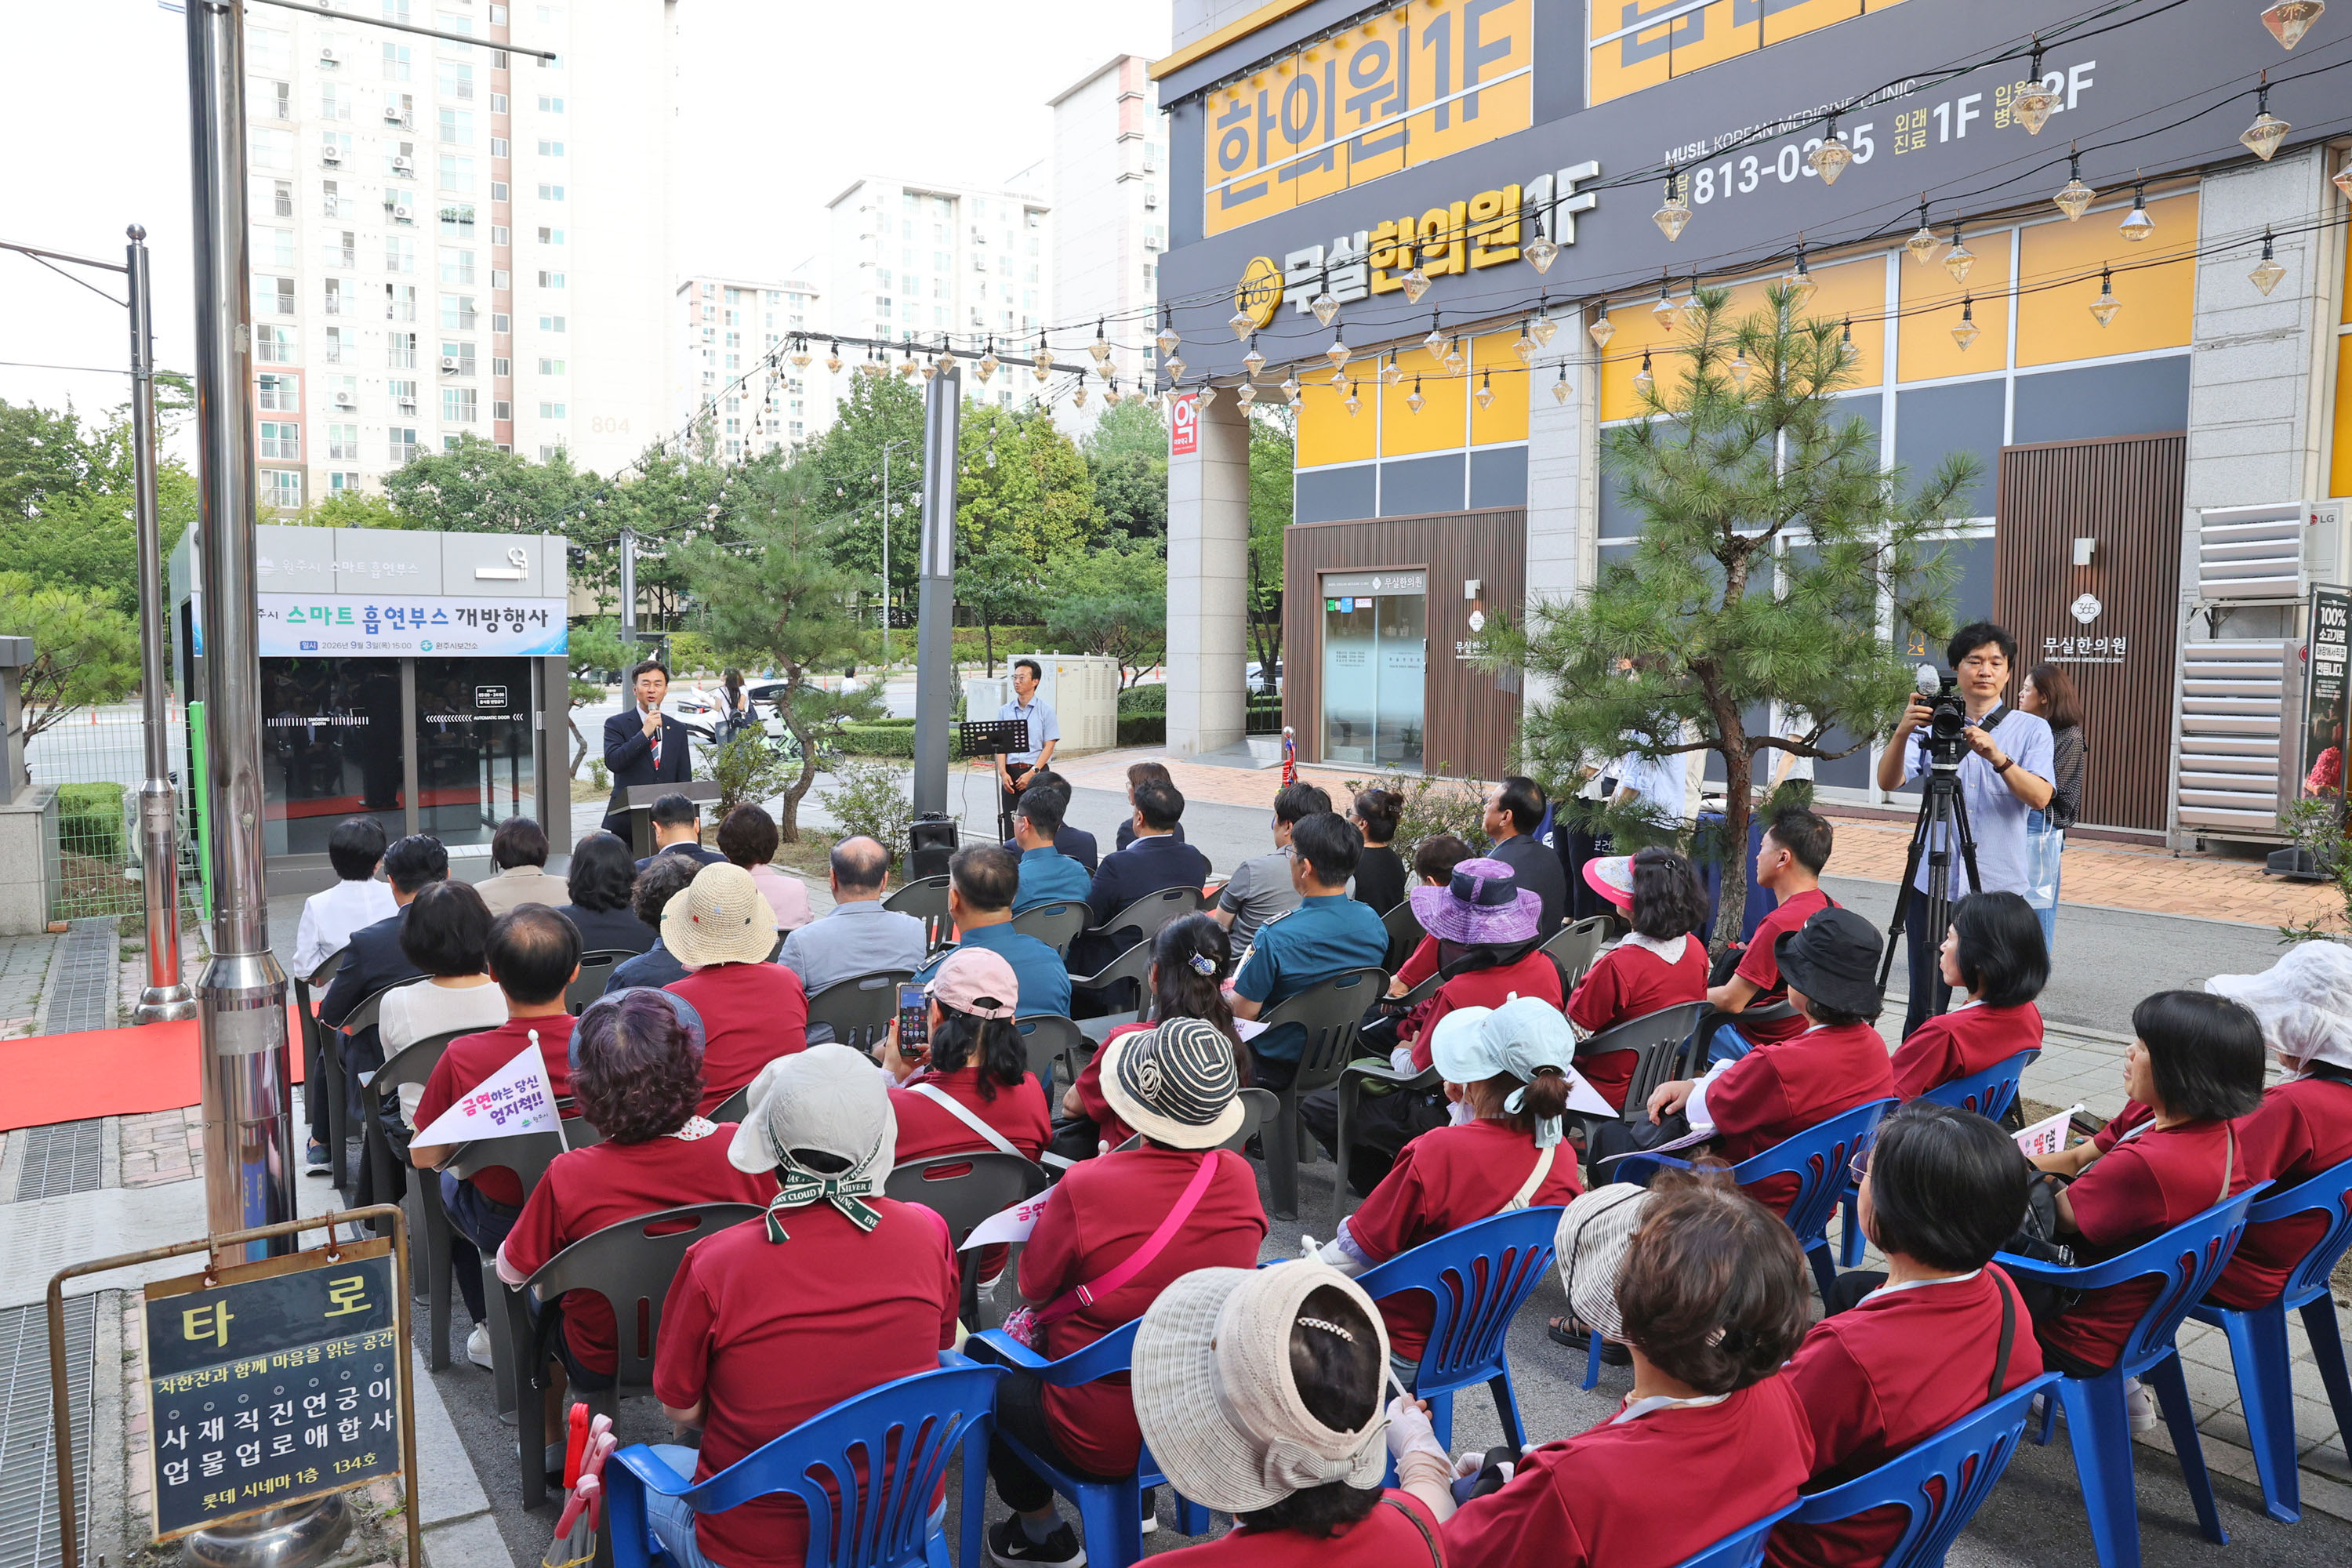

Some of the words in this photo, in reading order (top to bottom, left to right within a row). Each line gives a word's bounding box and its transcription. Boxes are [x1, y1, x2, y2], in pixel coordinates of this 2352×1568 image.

[2040, 60, 2096, 114] 2F
[1664, 140, 1710, 165] MUSIL
[1715, 121, 1773, 151] KOREAN
[1778, 96, 1854, 133] MEDICINE
[1860, 79, 1916, 110] CLINIC
[1894, 107, 1927, 133] 외래
[1933, 93, 1982, 143] 1F
[1994, 107, 2024, 129] 병
[1894, 129, 1926, 155] 진료
[1693, 123, 1875, 205] 813-035
[591, 416, 630, 433] 804
[1174, 399, 1198, 443] 약
[2320, 514, 2335, 524] LG
[281, 559, 321, 576] 원주시
[328, 561, 366, 573] 스마트
[369, 561, 419, 579] 흡연부스
[1385, 575, 1423, 589] 무실한의원
[286, 605, 354, 626] 스마트
[362, 604, 449, 635] 흡연부스
[456, 607, 549, 633] 개방행사
[2076, 602, 2096, 615] 365
[2320, 606, 2347, 627] 100%
[301, 641, 318, 650] 일시
[321, 641, 349, 650] 2026년
[350, 641, 364, 650] 9월
[435, 641, 478, 651] 원주시보건소
[2042, 636, 2127, 655] 무실한의원
[2318, 627, 2346, 643] 소고기로
[462, 1087, 514, 1117] 금연하는
[514, 1074, 539, 1094] 당신
[490, 1091, 544, 1126] 엄지척!!
[787, 1190, 818, 1202] CLOUD
[840, 1182, 868, 1193] SILVER
[158, 1368, 228, 1395] 차한잔과
[234, 1358, 267, 1381] 함께
[272, 1346, 321, 1370] 마음을
[325, 1340, 358, 1359] 읽는
[361, 1330, 394, 1352] 공간
[201, 1488, 236, 1512] 롯데
[241, 1475, 291, 1499] 시네마
[296, 1467, 319, 1486] 1층
[332, 1451, 378, 1475] 134호
